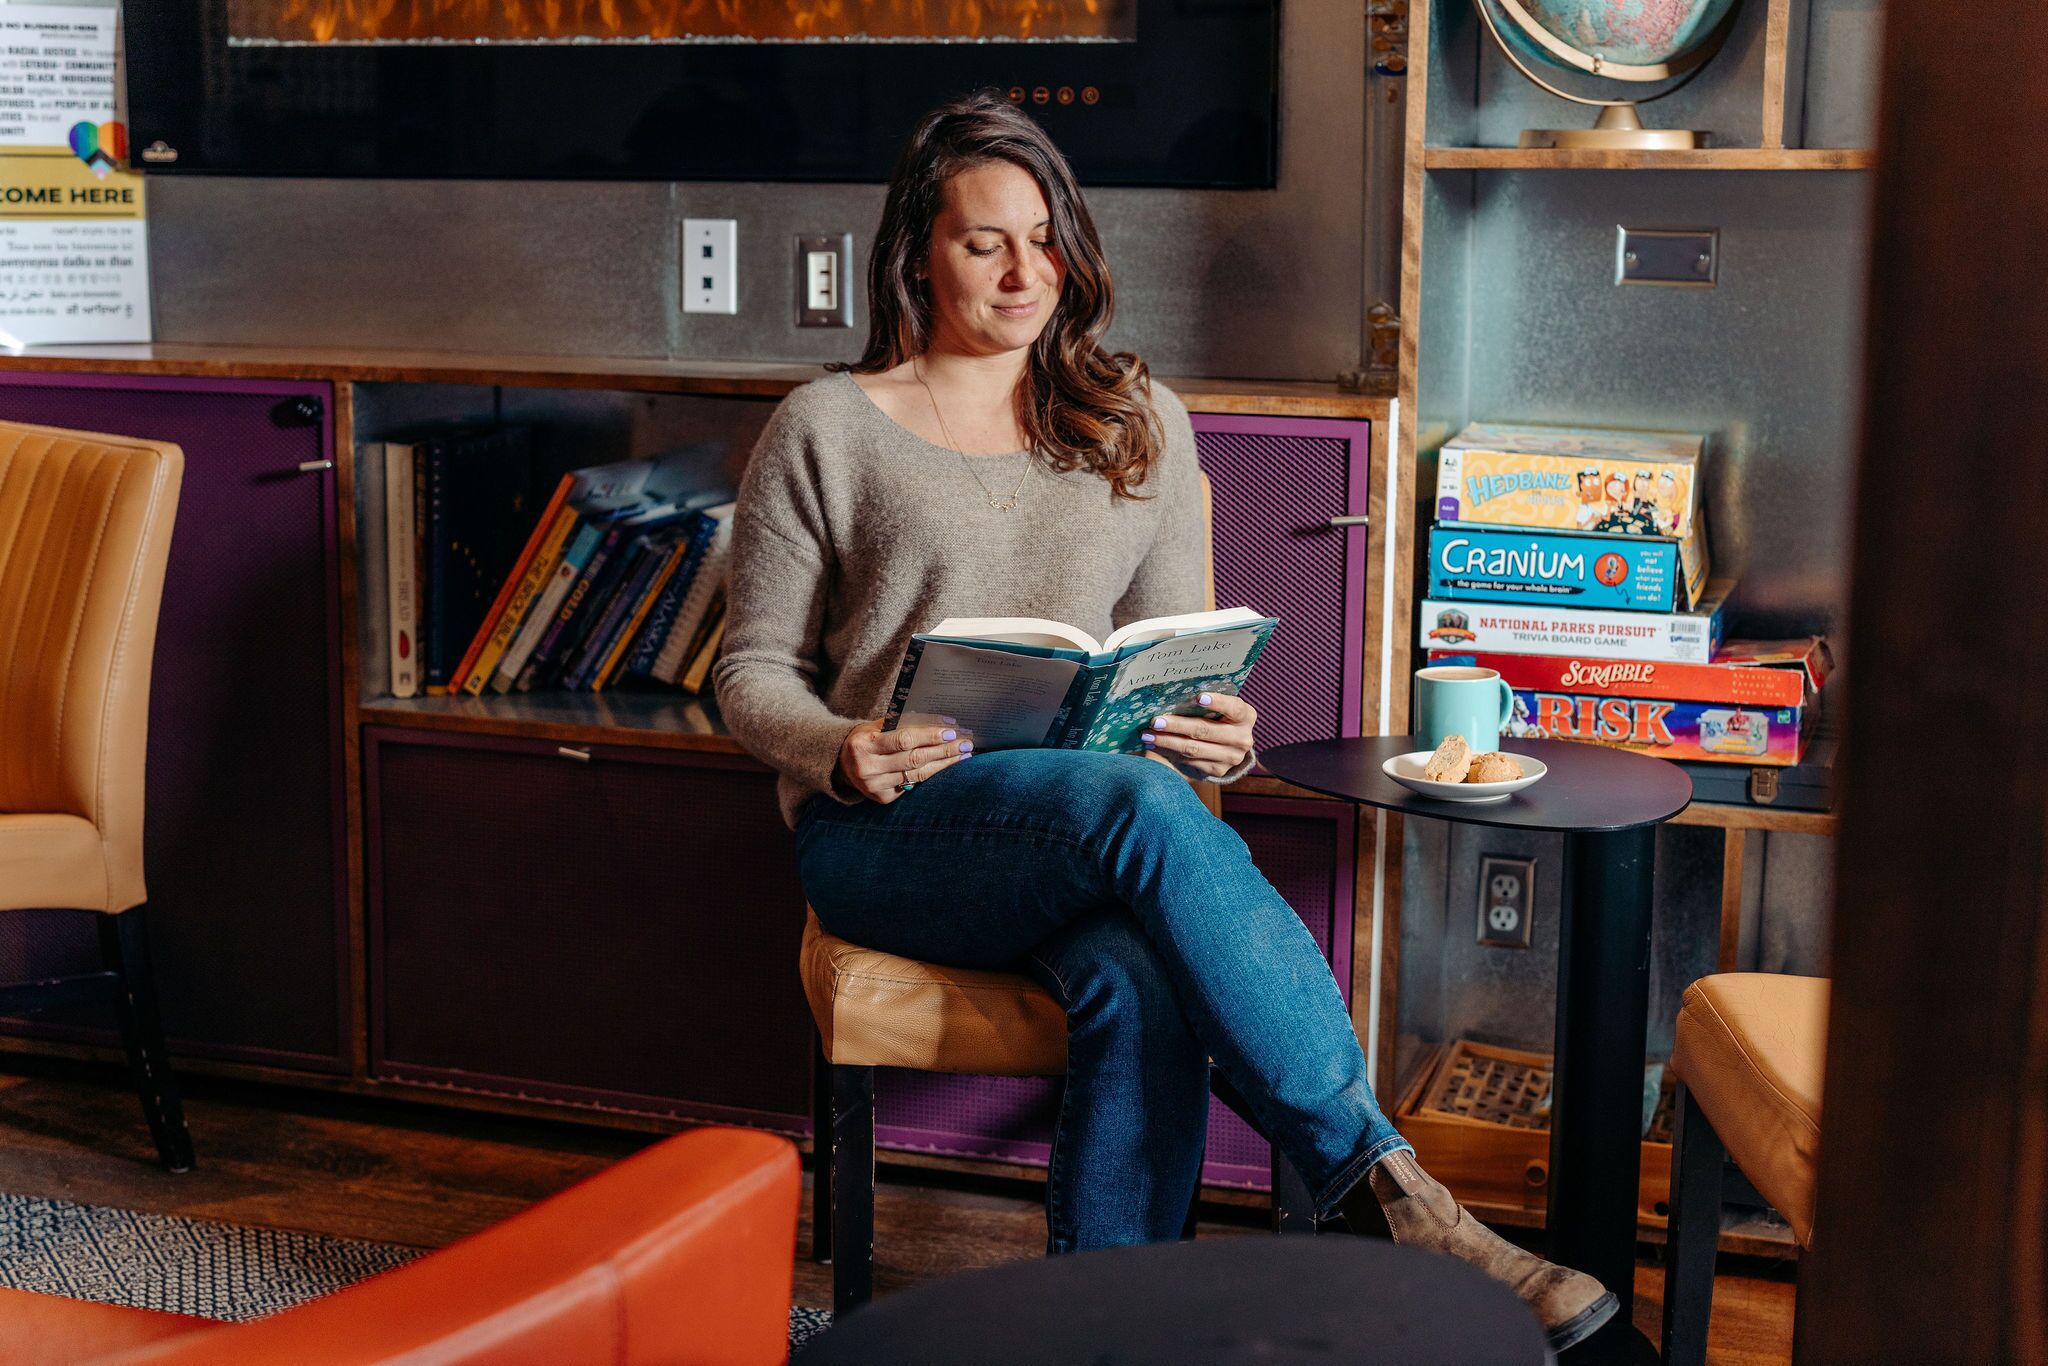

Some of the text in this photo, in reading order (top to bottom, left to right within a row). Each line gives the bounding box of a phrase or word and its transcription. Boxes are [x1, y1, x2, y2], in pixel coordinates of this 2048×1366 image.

[0, 187, 134, 204] OME HERE
[1466, 471, 1571, 507] HEDBANZ
[1637, 565, 1663, 574] believe
[1457, 580, 1572, 594] the game for your whole brain
[1636, 583, 1661, 592] friends
[560, 578, 590, 622] GOLD
[1480, 617, 1657, 638] NATIONAL PARKS PURSUIT
[1513, 632, 1628, 647] TRIVIA BOARD GAME
[1148, 641, 1232, 663] Tom Lake
[1128, 660, 1232, 686] Ann Patchett
[1534, 693, 1676, 746] RISK
